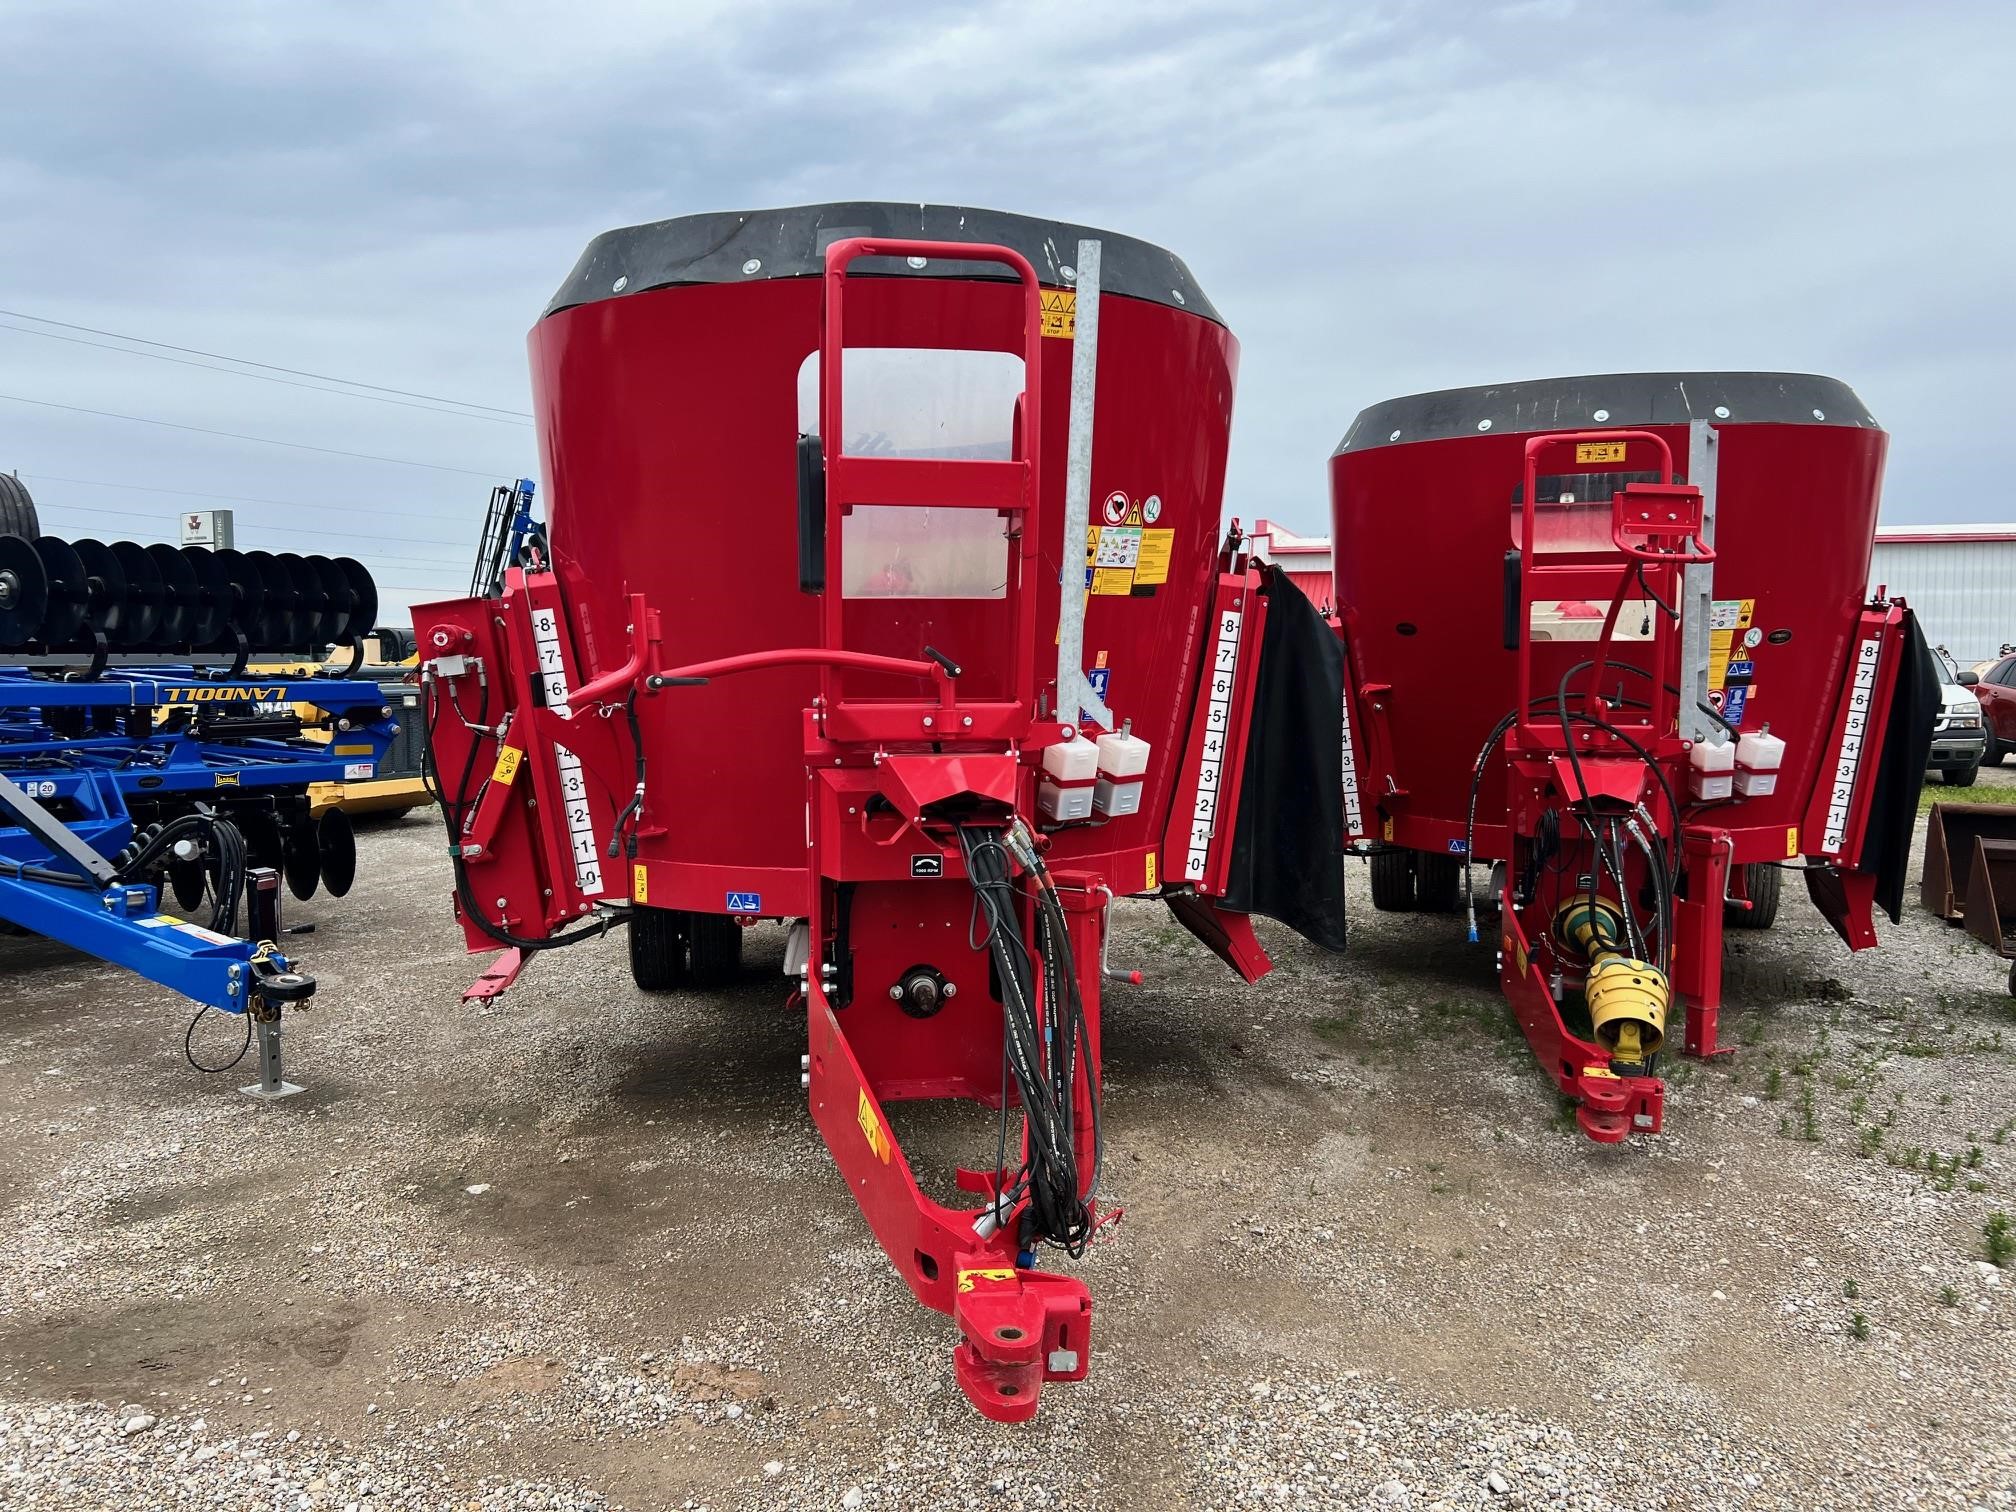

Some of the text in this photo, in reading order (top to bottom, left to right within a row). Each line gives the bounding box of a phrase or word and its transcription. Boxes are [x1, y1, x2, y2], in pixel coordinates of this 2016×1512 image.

[540, 618, 551, 631] 8
[1225, 620, 1234, 632] 8
[545, 650, 555, 663] 7
[1221, 650, 1230, 662] 7
[1865, 646, 1873, 657] 8
[1861, 671, 1869, 680] 7
[552, 682, 562, 695] 6
[1217, 680, 1225, 692] 6
[164, 687, 287, 702] LANDOLL
[1856, 694, 1864, 705] 6
[1213, 709, 1221, 722] 5
[1851, 718, 1859, 728] 5
[1208, 740, 1216, 752] 4
[1846, 742, 1854, 752] 4
[1344, 756, 1350, 765] 3
[1204, 769, 1213, 782] 3
[1842, 765, 1850, 775] 3
[42, 784, 53, 792] 20
[568, 777, 579, 791] 3
[1346, 778, 1353, 787] 2
[1837, 789, 1845, 799] 2
[1200, 799, 1209, 812] 2
[1350, 798, 1355, 807] 1
[574, 809, 585, 822] 2
[1834, 812, 1840, 822] 1
[1352, 820, 1358, 829] 0
[1197, 829, 1203, 841] 1
[581, 840, 588, 853] 1
[1191, 858, 1200, 870] 0
